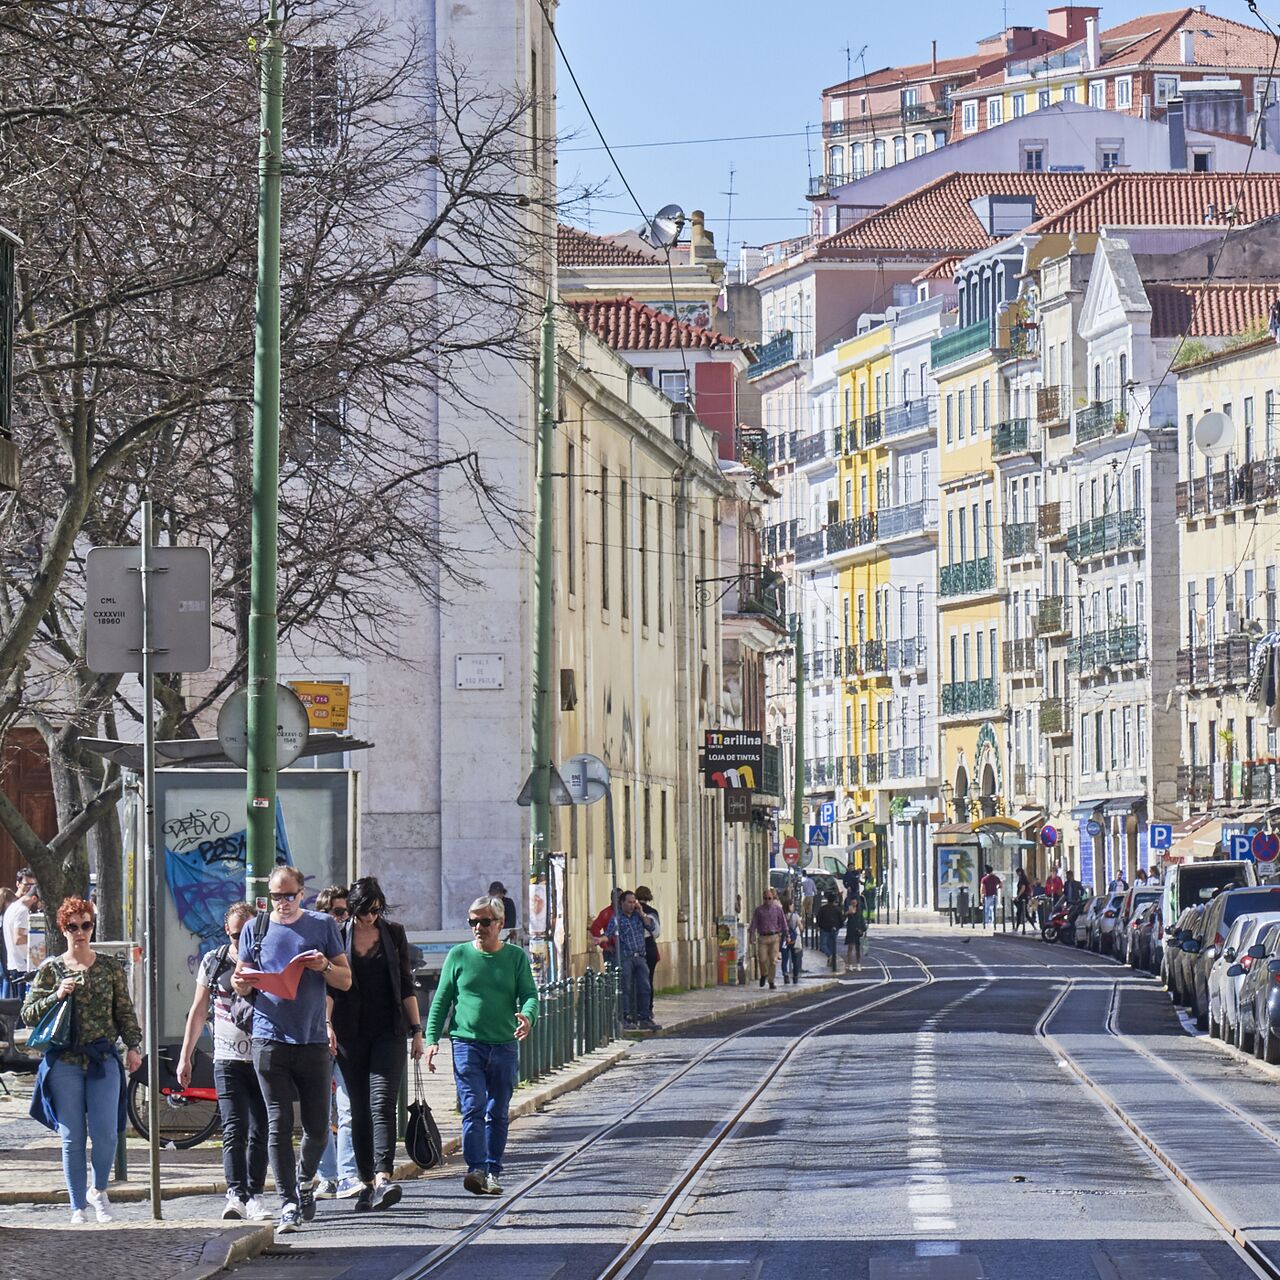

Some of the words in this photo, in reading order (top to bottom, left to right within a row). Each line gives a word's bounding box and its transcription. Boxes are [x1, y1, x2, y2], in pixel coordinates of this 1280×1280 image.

[707, 733, 761, 745] marilina
[824, 804, 832, 819] P
[1155, 828, 1167, 846] P
[1235, 837, 1249, 859] P
